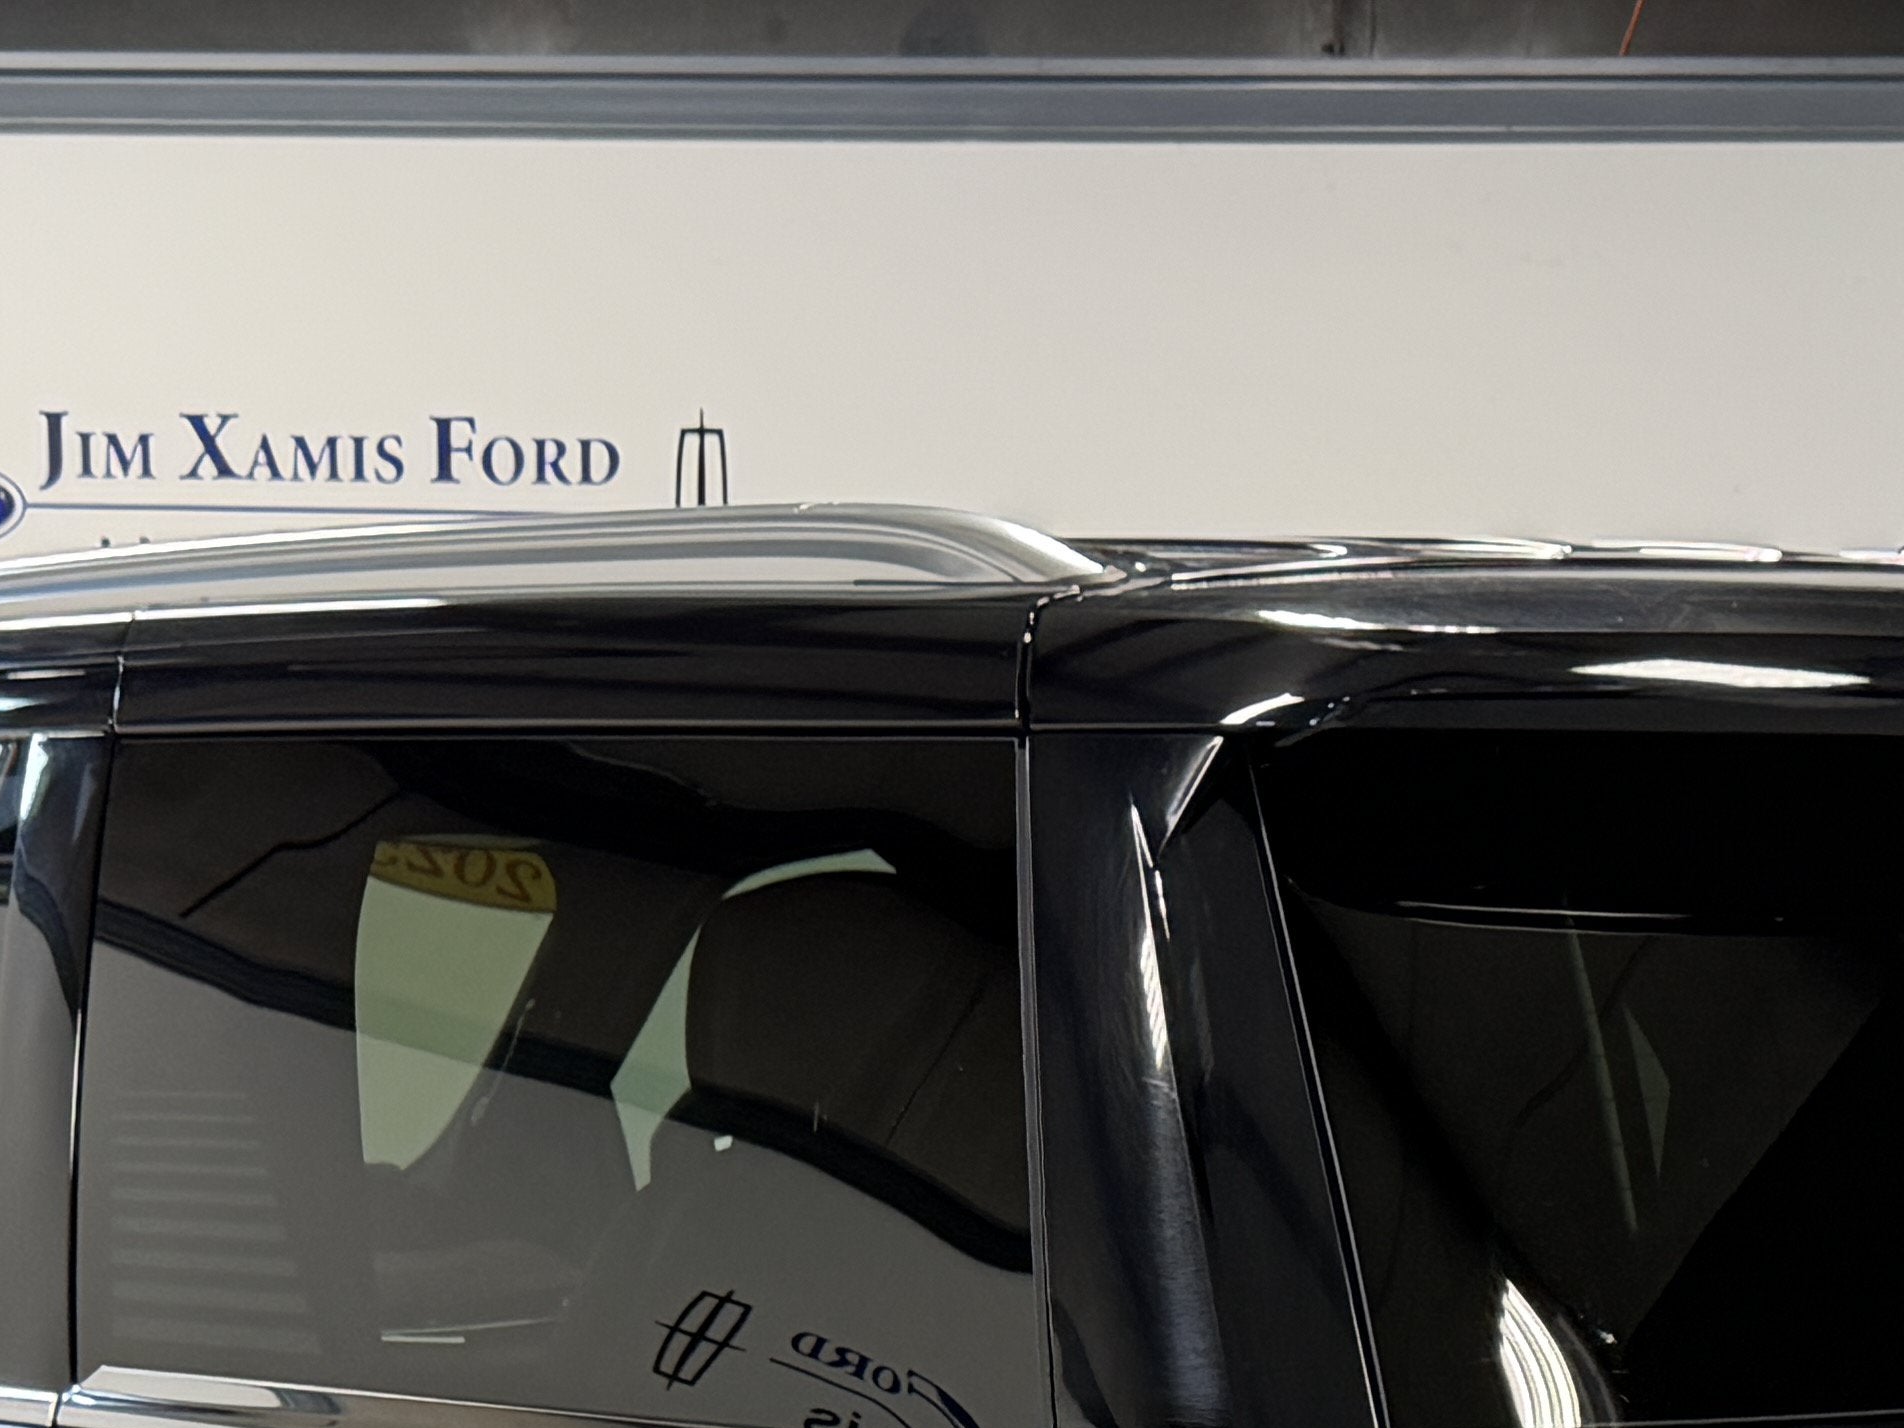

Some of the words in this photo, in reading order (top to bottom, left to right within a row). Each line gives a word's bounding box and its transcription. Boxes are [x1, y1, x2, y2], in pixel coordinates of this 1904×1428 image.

[39, 410, 156, 491] JIM
[179, 413, 404, 484] XAMIS
[430, 416, 620, 486] FORD
